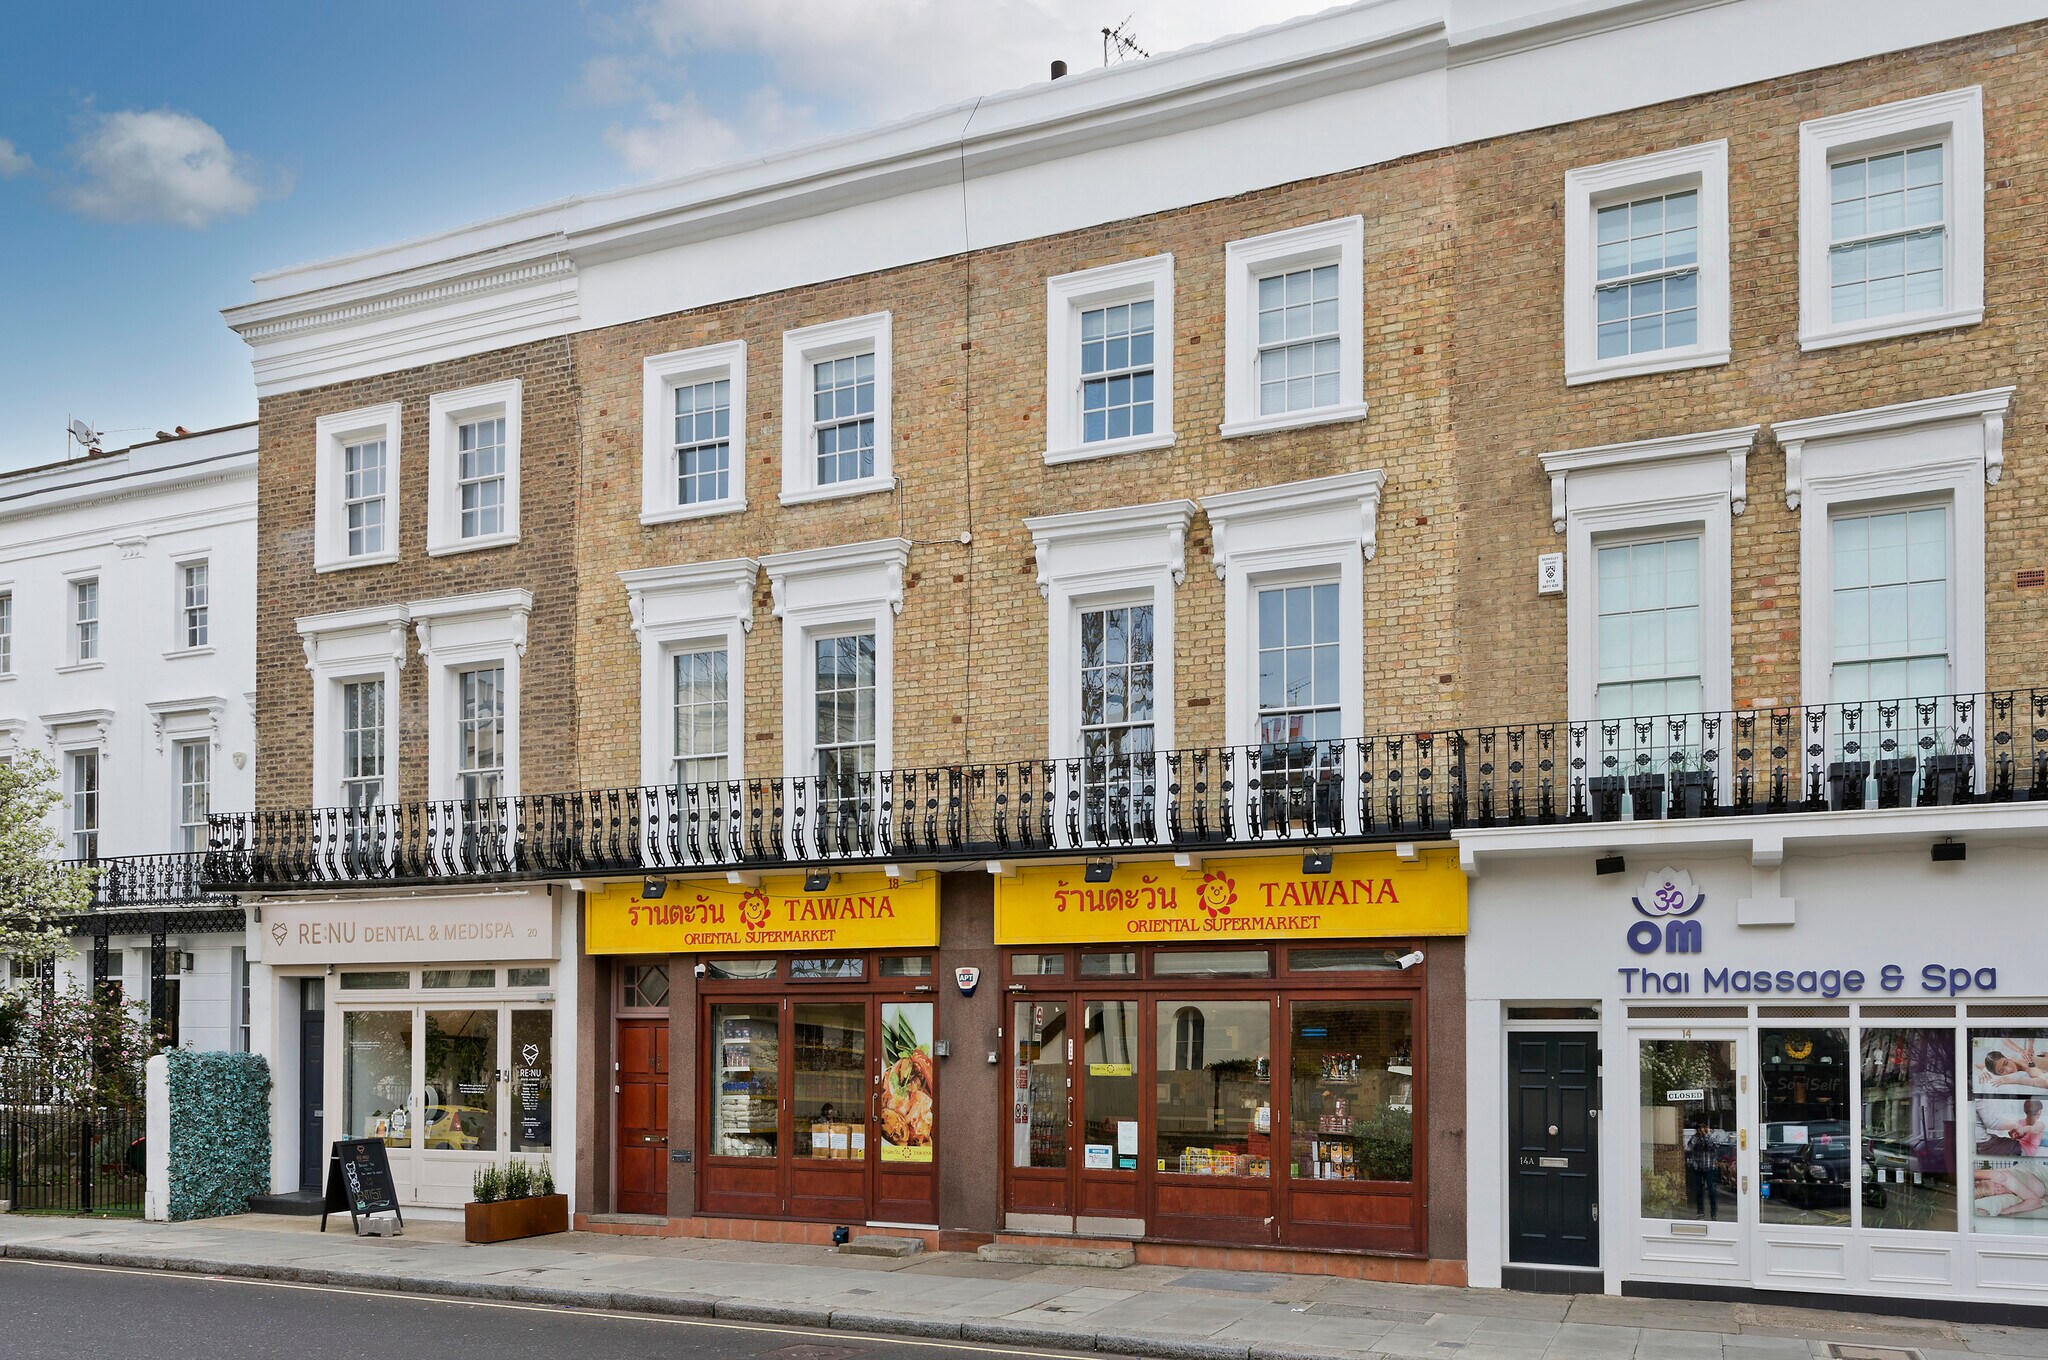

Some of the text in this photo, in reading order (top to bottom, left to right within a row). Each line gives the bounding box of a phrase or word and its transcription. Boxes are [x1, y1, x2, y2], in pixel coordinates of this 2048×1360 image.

[887, 878, 899, 890] 18
[1053, 874, 1178, 913] ร้านตะวัน
[1258, 878, 1400, 907] TAWANA
[627, 894, 725, 927] ร้านตะวัน
[783, 895, 896, 922] TAWANA
[1127, 915, 1322, 934] ORIENTAL SUPERMARKET
[299, 921, 515, 945] RE:NU DENTAL & MEDISPA
[527, 928, 538, 938] 20
[684, 929, 837, 945] ORIENTAL SUPERMARKET
[959, 974, 974, 982] APT
[1617, 964, 1998, 998] Thai Massage & Spa
[1681, 1029, 1692, 1039] 14
[1777, 1077, 1842, 1093] SolSelf
[1668, 1091, 1703, 1100] CLOSED
[1519, 1156, 1535, 1165] 14A
